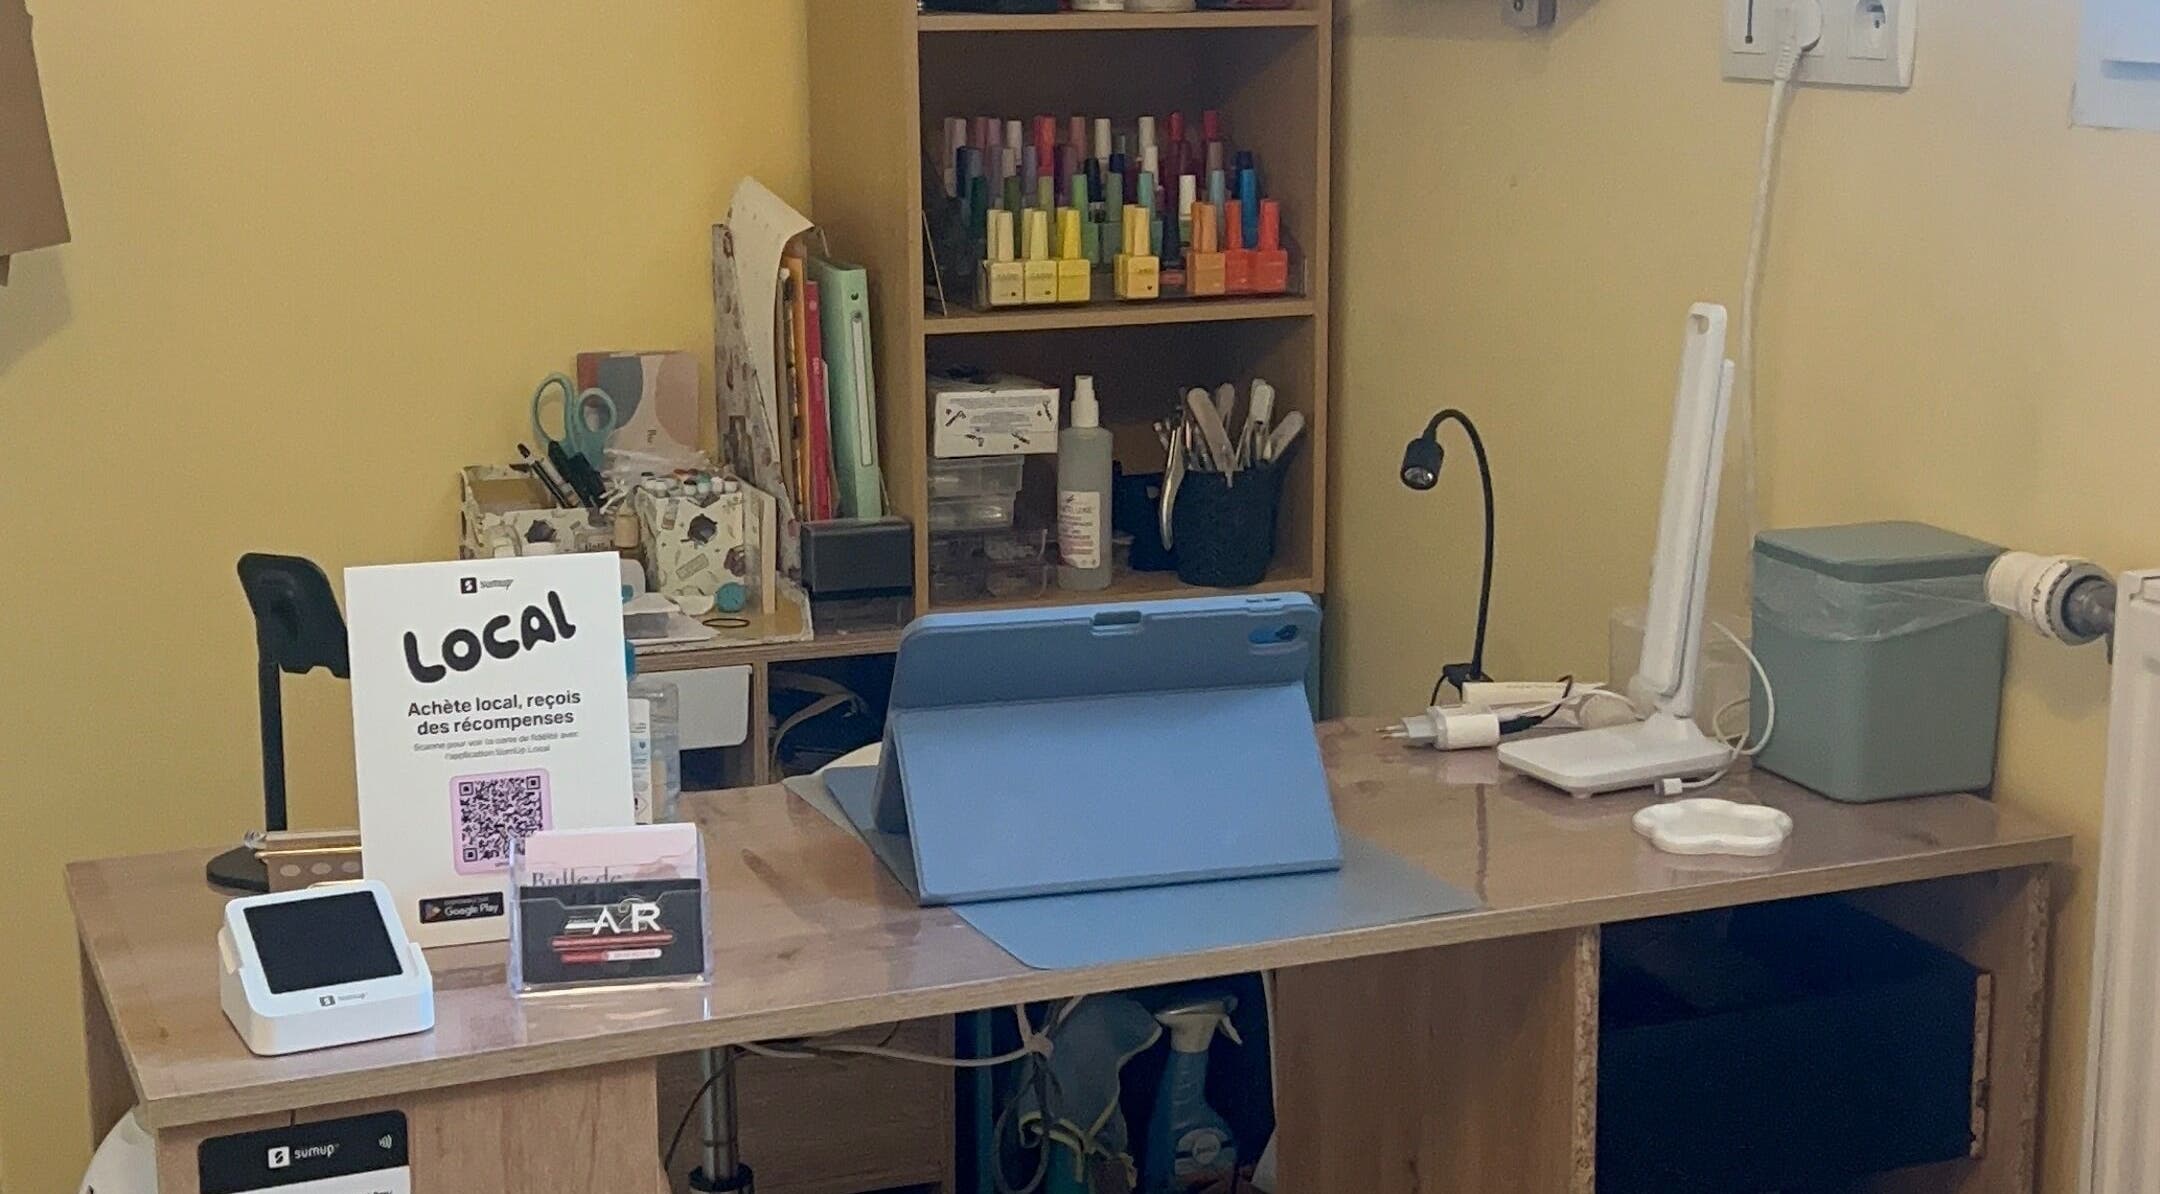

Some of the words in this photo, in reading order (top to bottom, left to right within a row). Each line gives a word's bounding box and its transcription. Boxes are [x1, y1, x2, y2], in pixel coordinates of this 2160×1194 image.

[408, 698, 472, 717] Achète
[476, 694, 523, 711] local,
[527, 690, 581, 709] reçois
[417, 721, 449, 735] des
[454, 711, 574, 731] récompenses
[294, 1144, 335, 1159] sumup
